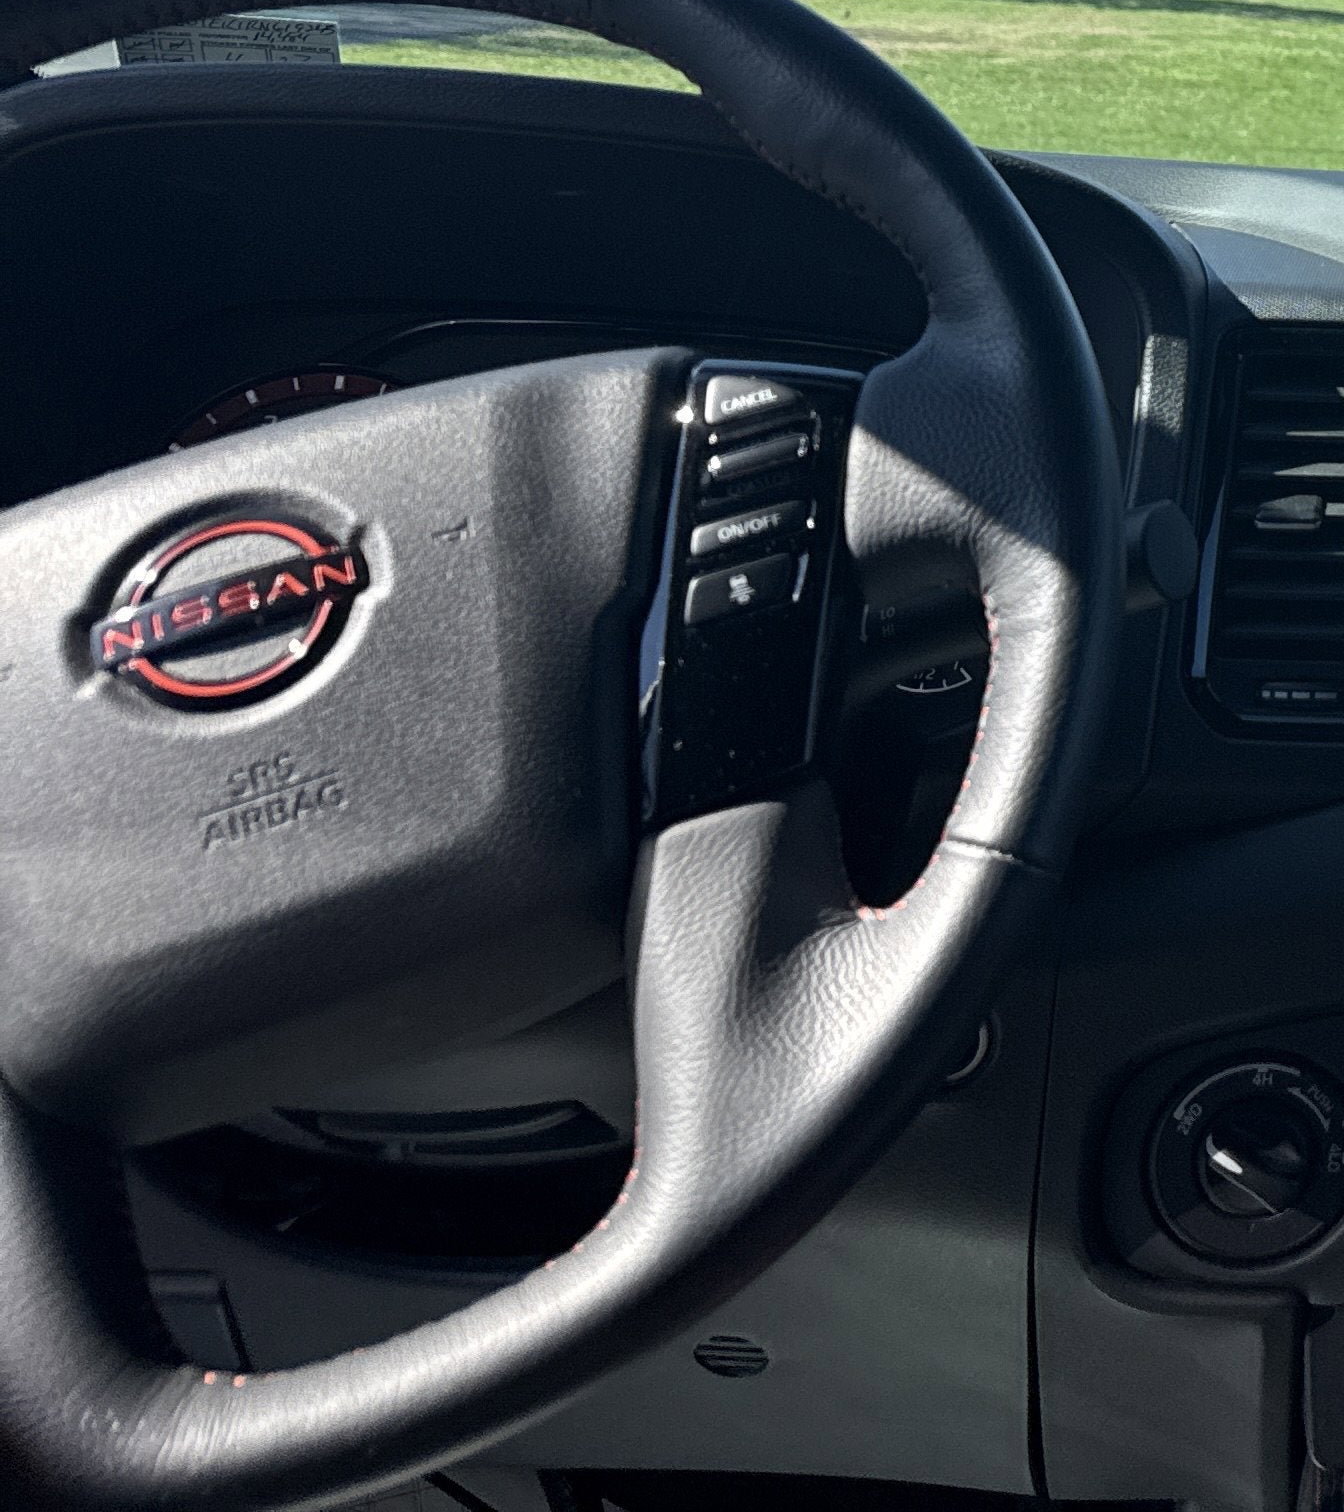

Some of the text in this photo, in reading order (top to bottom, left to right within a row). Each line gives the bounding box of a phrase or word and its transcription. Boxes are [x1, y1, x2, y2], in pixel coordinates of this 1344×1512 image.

[720, 388, 778, 415] CANCEL
[717, 512, 782, 544] ON/OFF
[103, 555, 356, 661] NISSAN
[202, 780, 346, 850] AIRBAG
[1252, 1072, 1274, 1086] 4H
